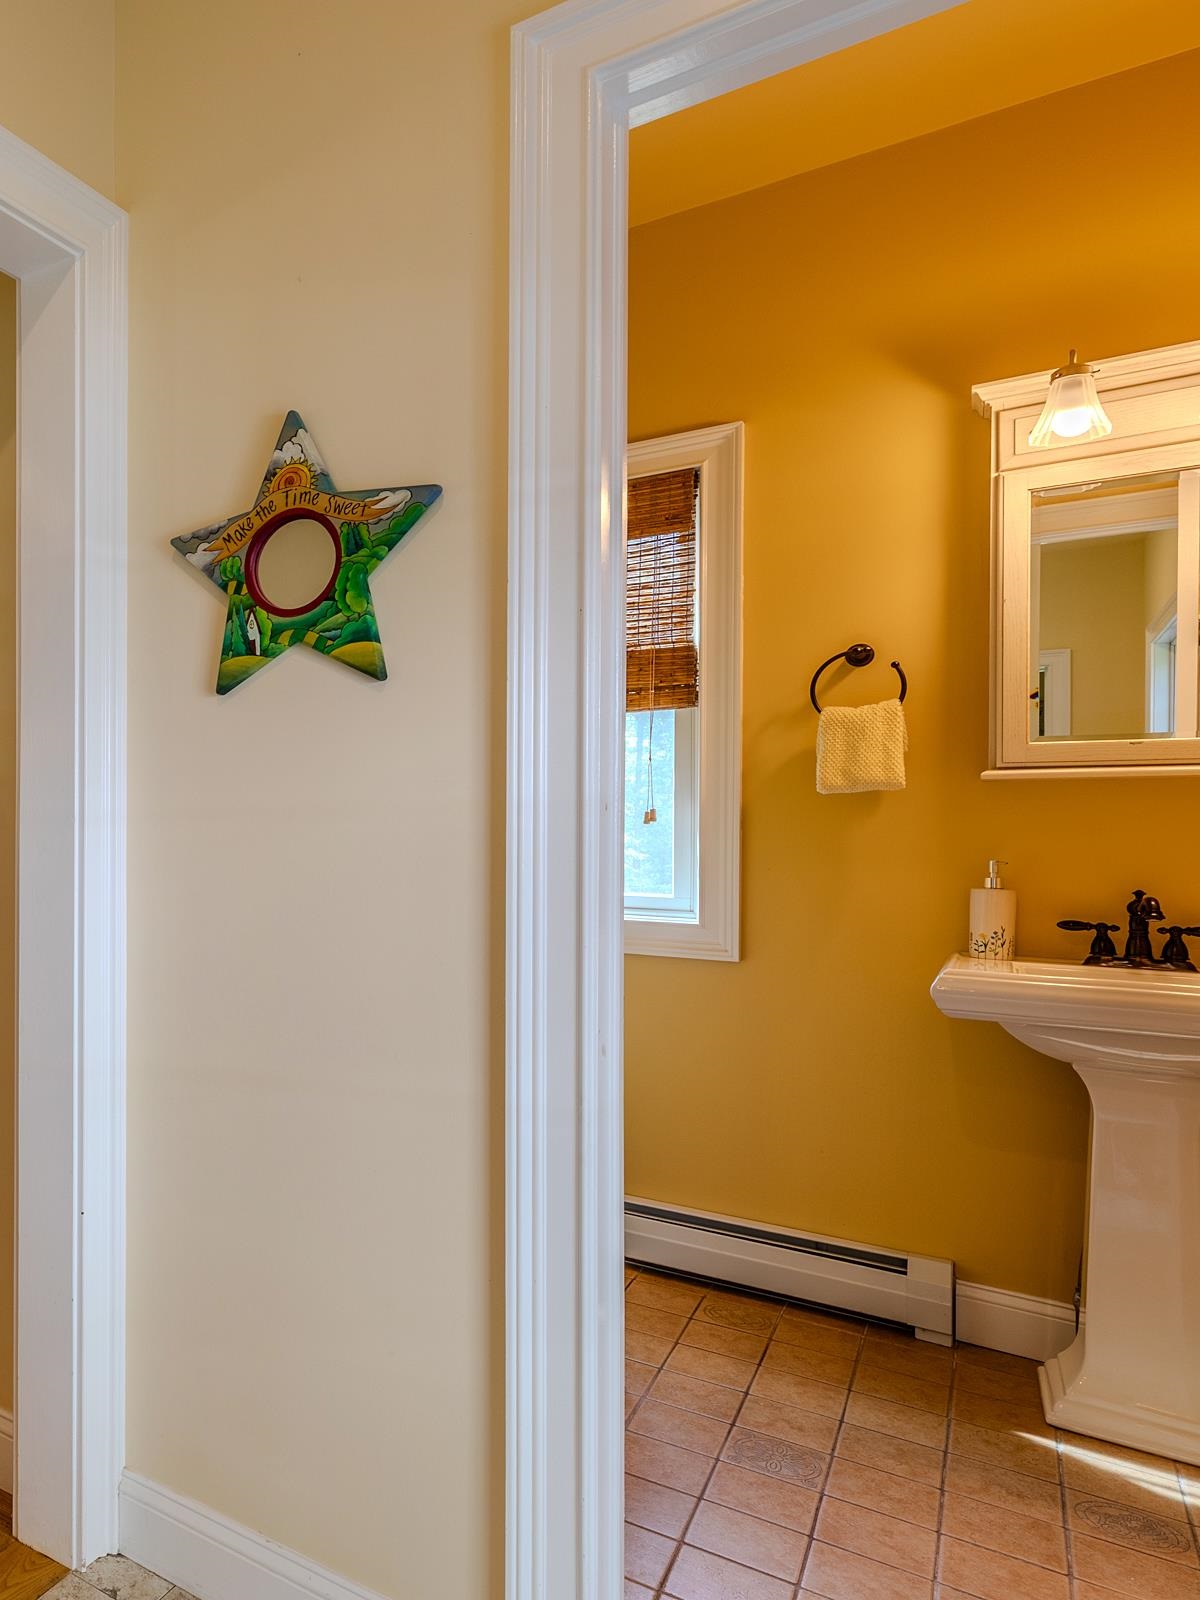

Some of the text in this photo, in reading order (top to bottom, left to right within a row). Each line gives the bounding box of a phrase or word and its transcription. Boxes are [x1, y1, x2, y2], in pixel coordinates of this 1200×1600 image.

[222, 487, 369, 553] Make the Time Sweet
